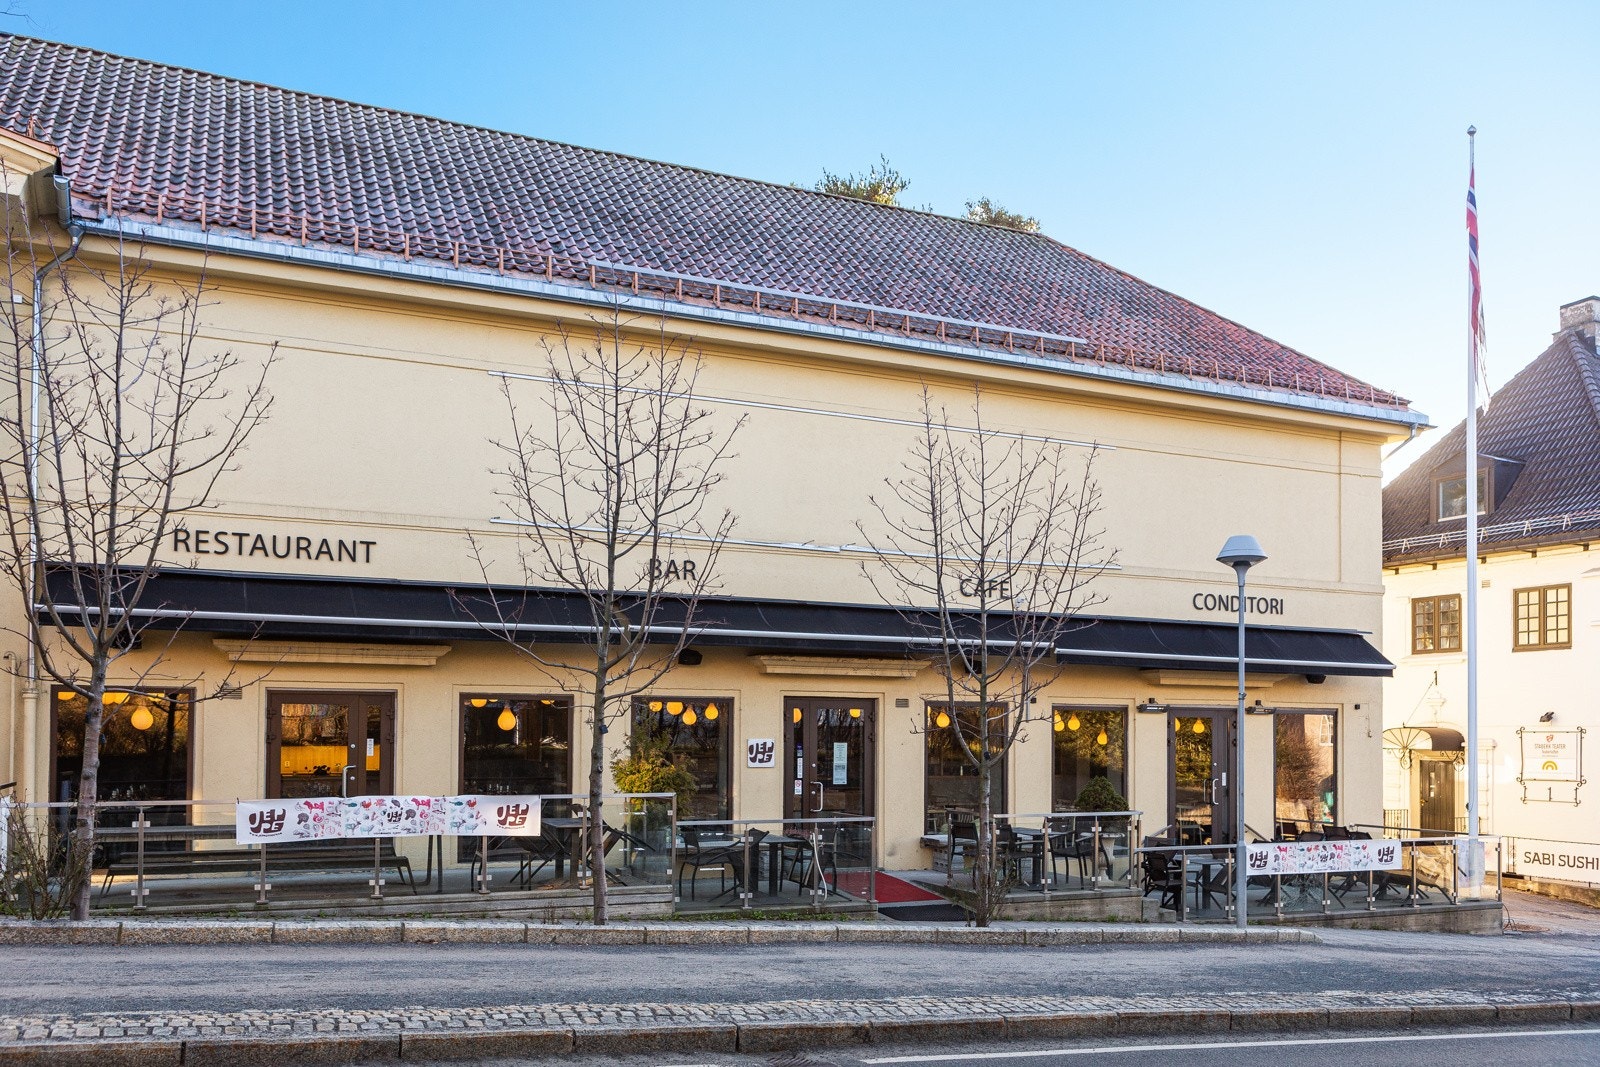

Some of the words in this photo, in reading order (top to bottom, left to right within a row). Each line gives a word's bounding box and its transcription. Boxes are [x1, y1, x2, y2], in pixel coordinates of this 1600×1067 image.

[173, 529, 377, 564] RESTAURANT
[650, 559, 696, 580] BAR
[960, 578, 1010, 600] CAFE
[1192, 593, 1284, 615] CONDITORI
[1524, 851, 1555, 866] SABI
[1558, 854, 1599, 870] SUSHI
